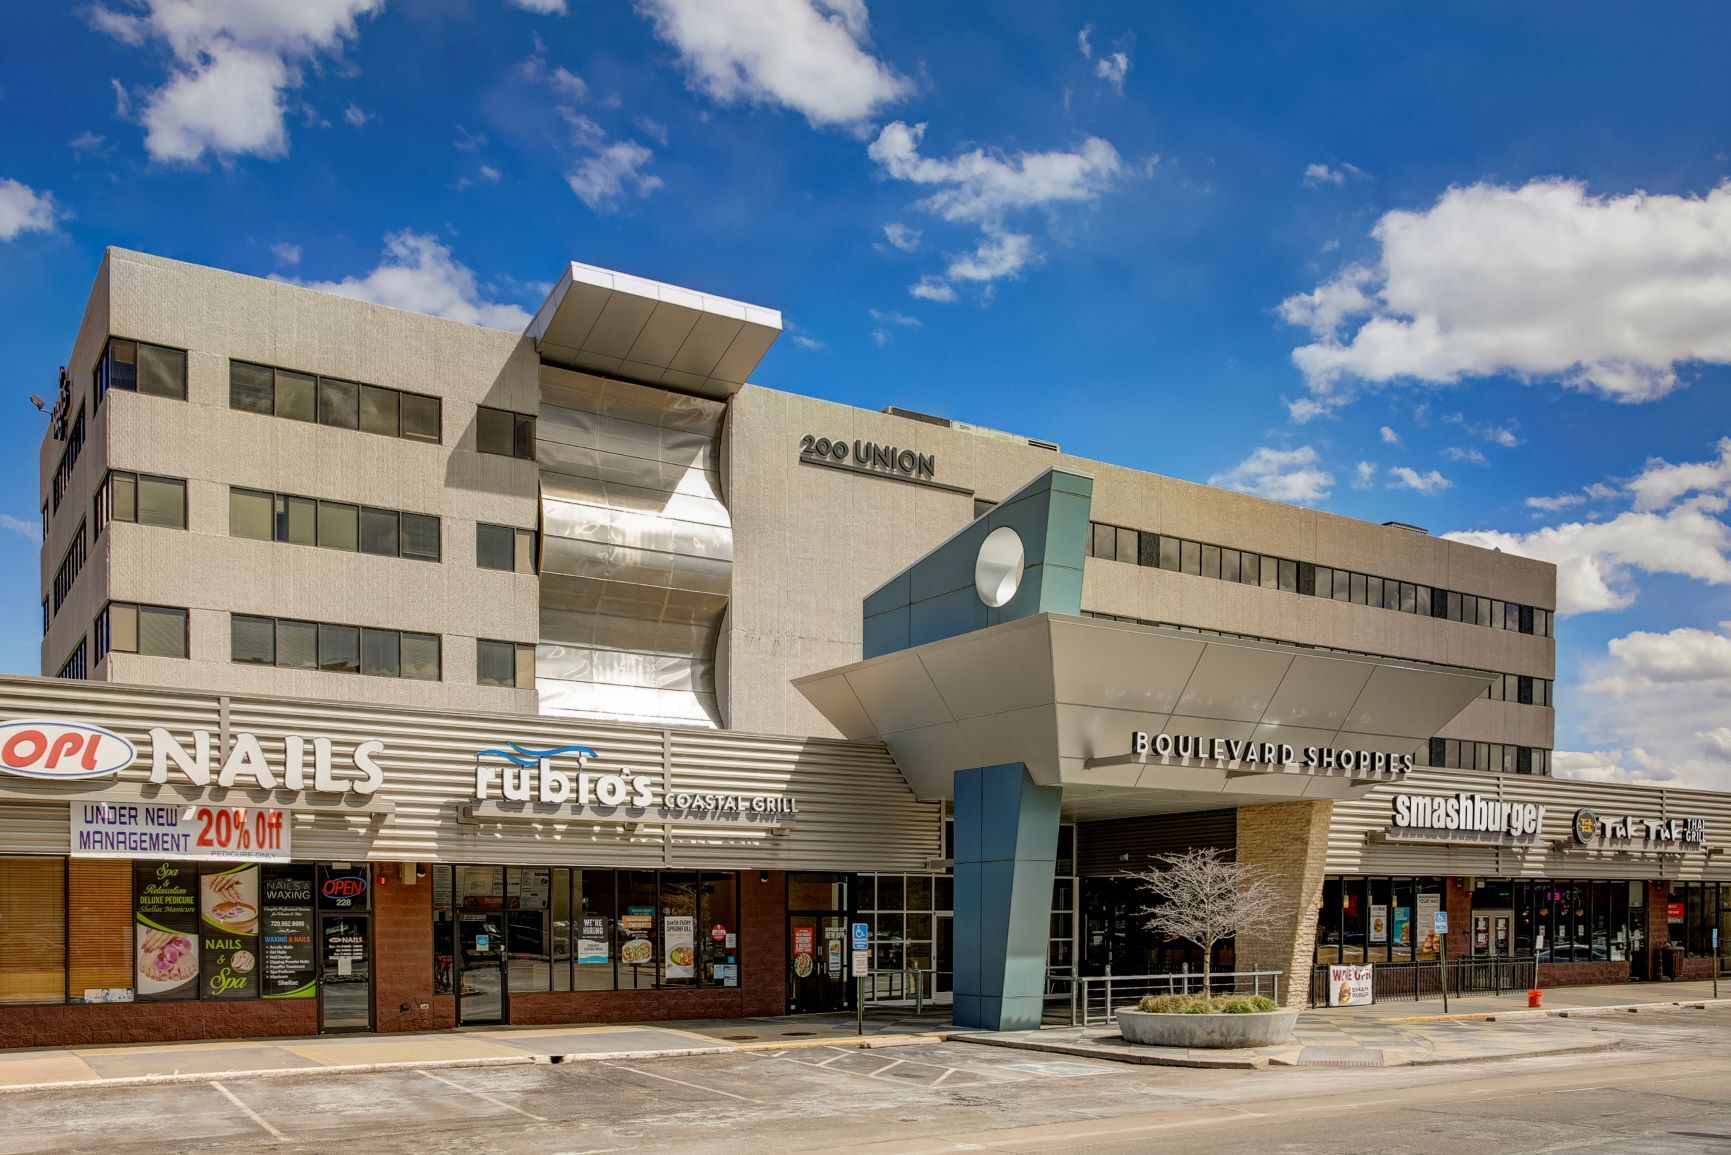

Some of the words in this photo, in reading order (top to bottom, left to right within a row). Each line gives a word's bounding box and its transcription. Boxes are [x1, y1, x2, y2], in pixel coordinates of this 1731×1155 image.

[800, 434, 849, 460] 200
[854, 440, 935, 476] UNION
[2, 730, 102, 770] OPI
[148, 727, 384, 794] NAILS
[1133, 731, 1294, 764] BOULEVARD
[1305, 746, 1412, 774] SHOPPES
[475, 756, 653, 807] rubio's
[664, 792, 748, 813] COASTAL
[752, 796, 799, 814] GRILL
[84, 805, 138, 825] UNDER
[146, 808, 178, 826] NEW
[1394, 794, 1546, 836] smashburger
[1687, 818, 1704, 830] THAI
[196, 808, 250, 849] 20%
[256, 811, 283, 849] Off
[1599, 816, 1638, 839] Tuk
[1644, 820, 1682, 842] Tuk
[1686, 830, 1706, 842] GRILL
[79, 830, 190, 852] MANAGEMENT
[156, 863, 179, 880] Spa
[143, 884, 187, 894] Relaxation
[267, 880, 300, 890] NAILS
[267, 891, 310, 900] WAXING
[323, 880, 363, 895] OPEN
[140, 896, 164, 904] DELUXE
[165, 896, 194, 904] PEDICURE
[206, 939, 242, 950] NAILS
[217, 954, 226, 964] &
[210, 967, 248, 995] Spa
